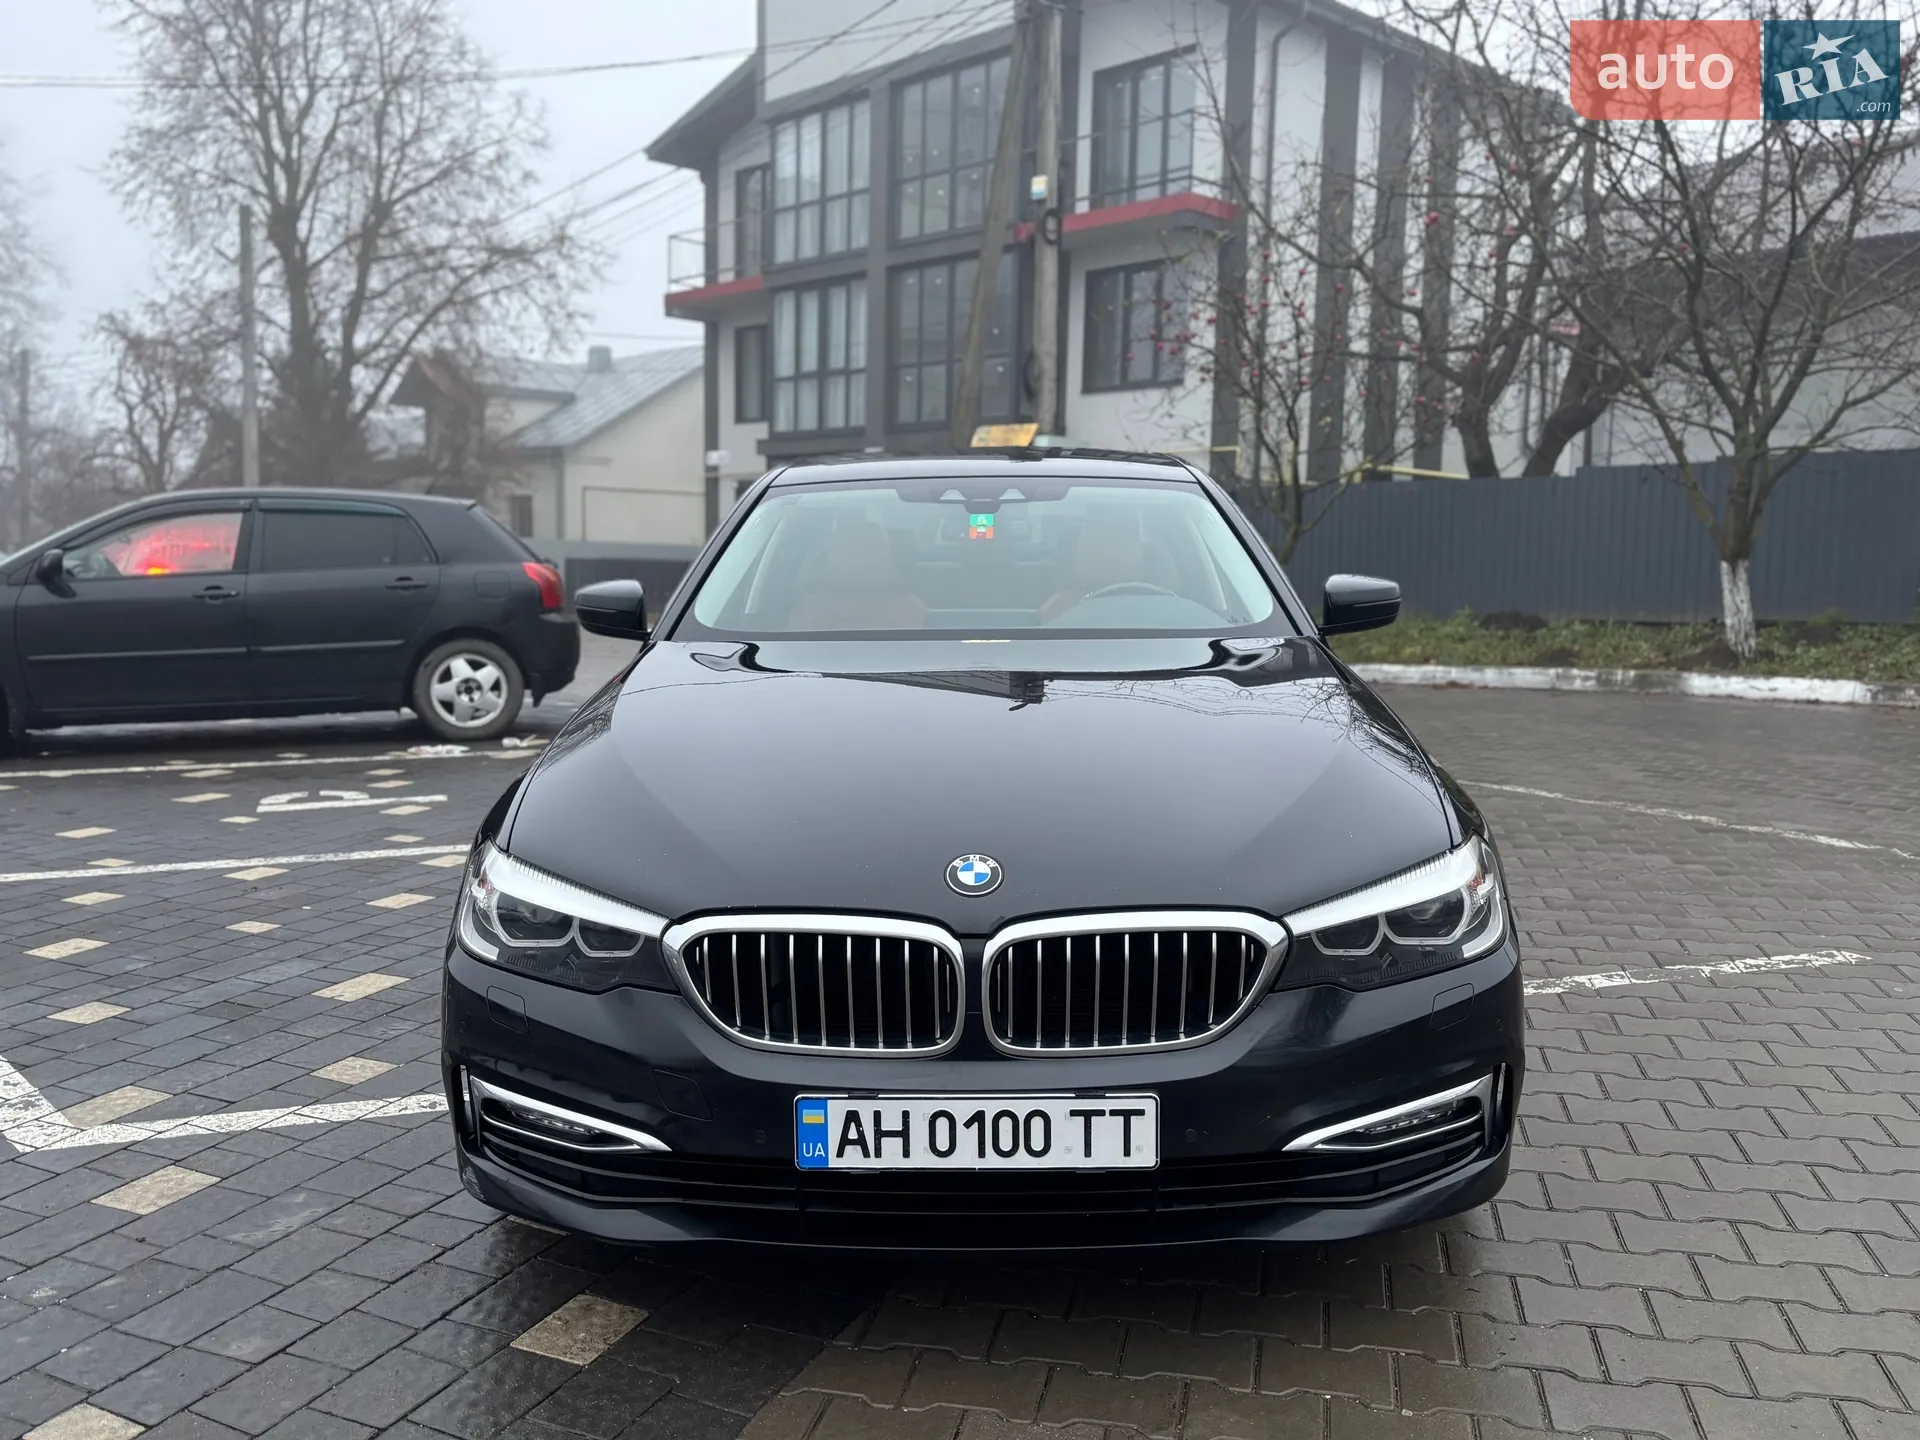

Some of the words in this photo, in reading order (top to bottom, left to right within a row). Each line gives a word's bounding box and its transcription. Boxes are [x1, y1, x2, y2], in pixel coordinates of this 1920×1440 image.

[952, 855, 997, 868] BMW
[835, 1109, 910, 1158] AH
[928, 1109, 1052, 1158] 0100
[1069, 1108, 1146, 1158] TT
[803, 1142, 826, 1158] UA
